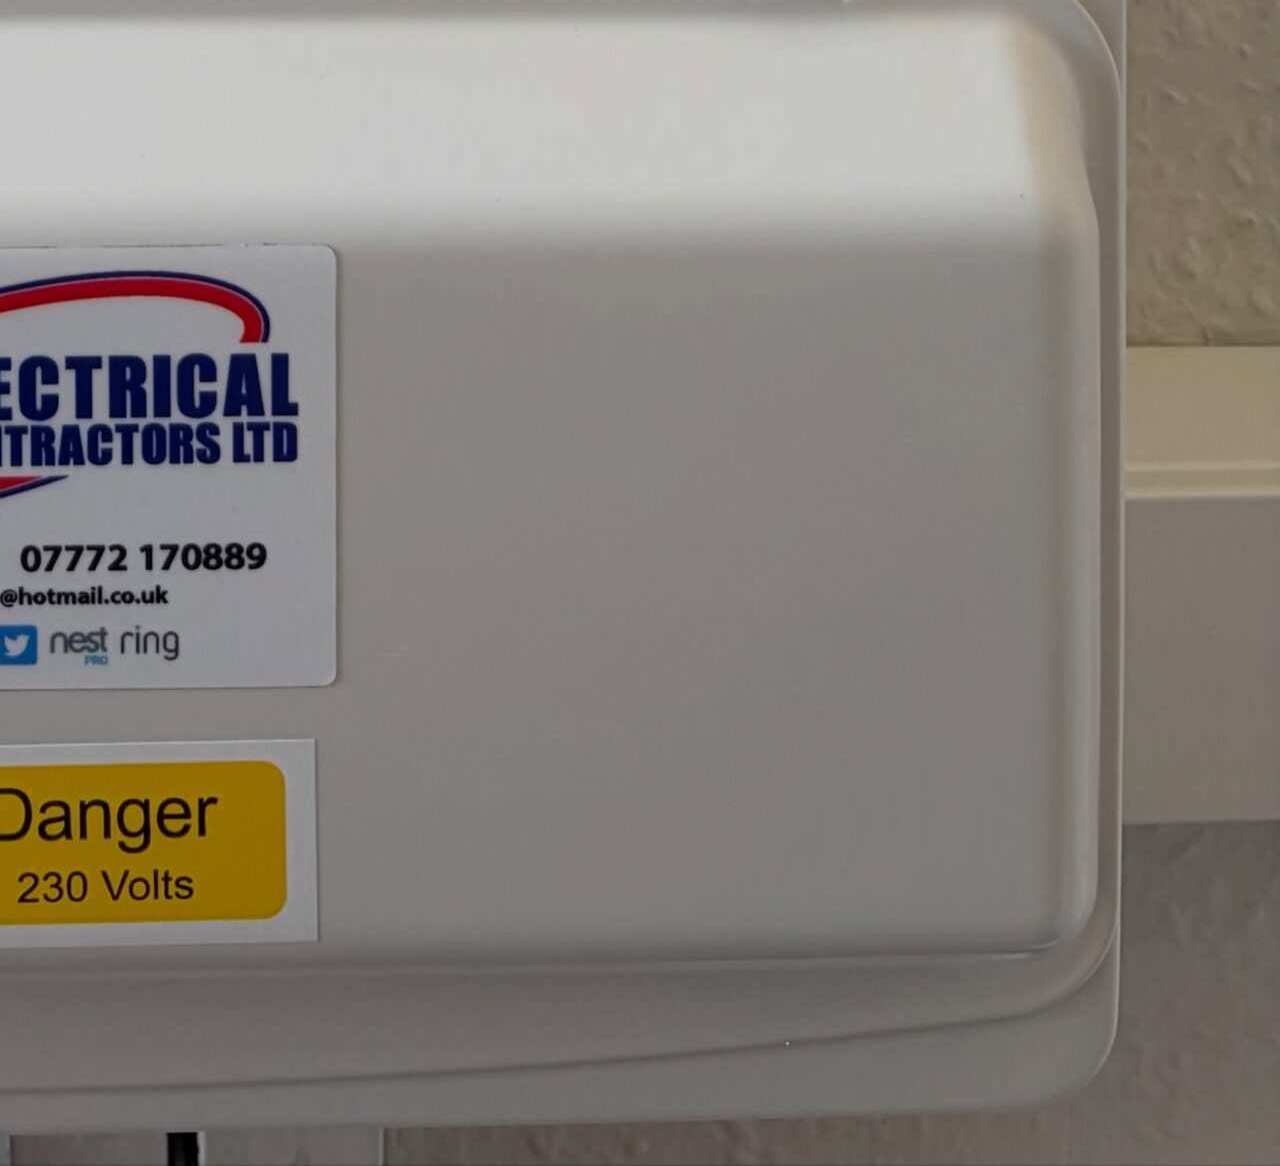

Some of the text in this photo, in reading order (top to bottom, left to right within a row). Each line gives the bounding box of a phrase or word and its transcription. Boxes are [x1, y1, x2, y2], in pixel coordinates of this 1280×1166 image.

[231, 420, 298, 464] LTD
[20, 541, 268, 574] 07772 170889
[49, 626, 108, 654] nest
[120, 624, 180, 662] ring
[84, 655, 109, 666] PRO
[17, 868, 195, 904] 230 Volts
